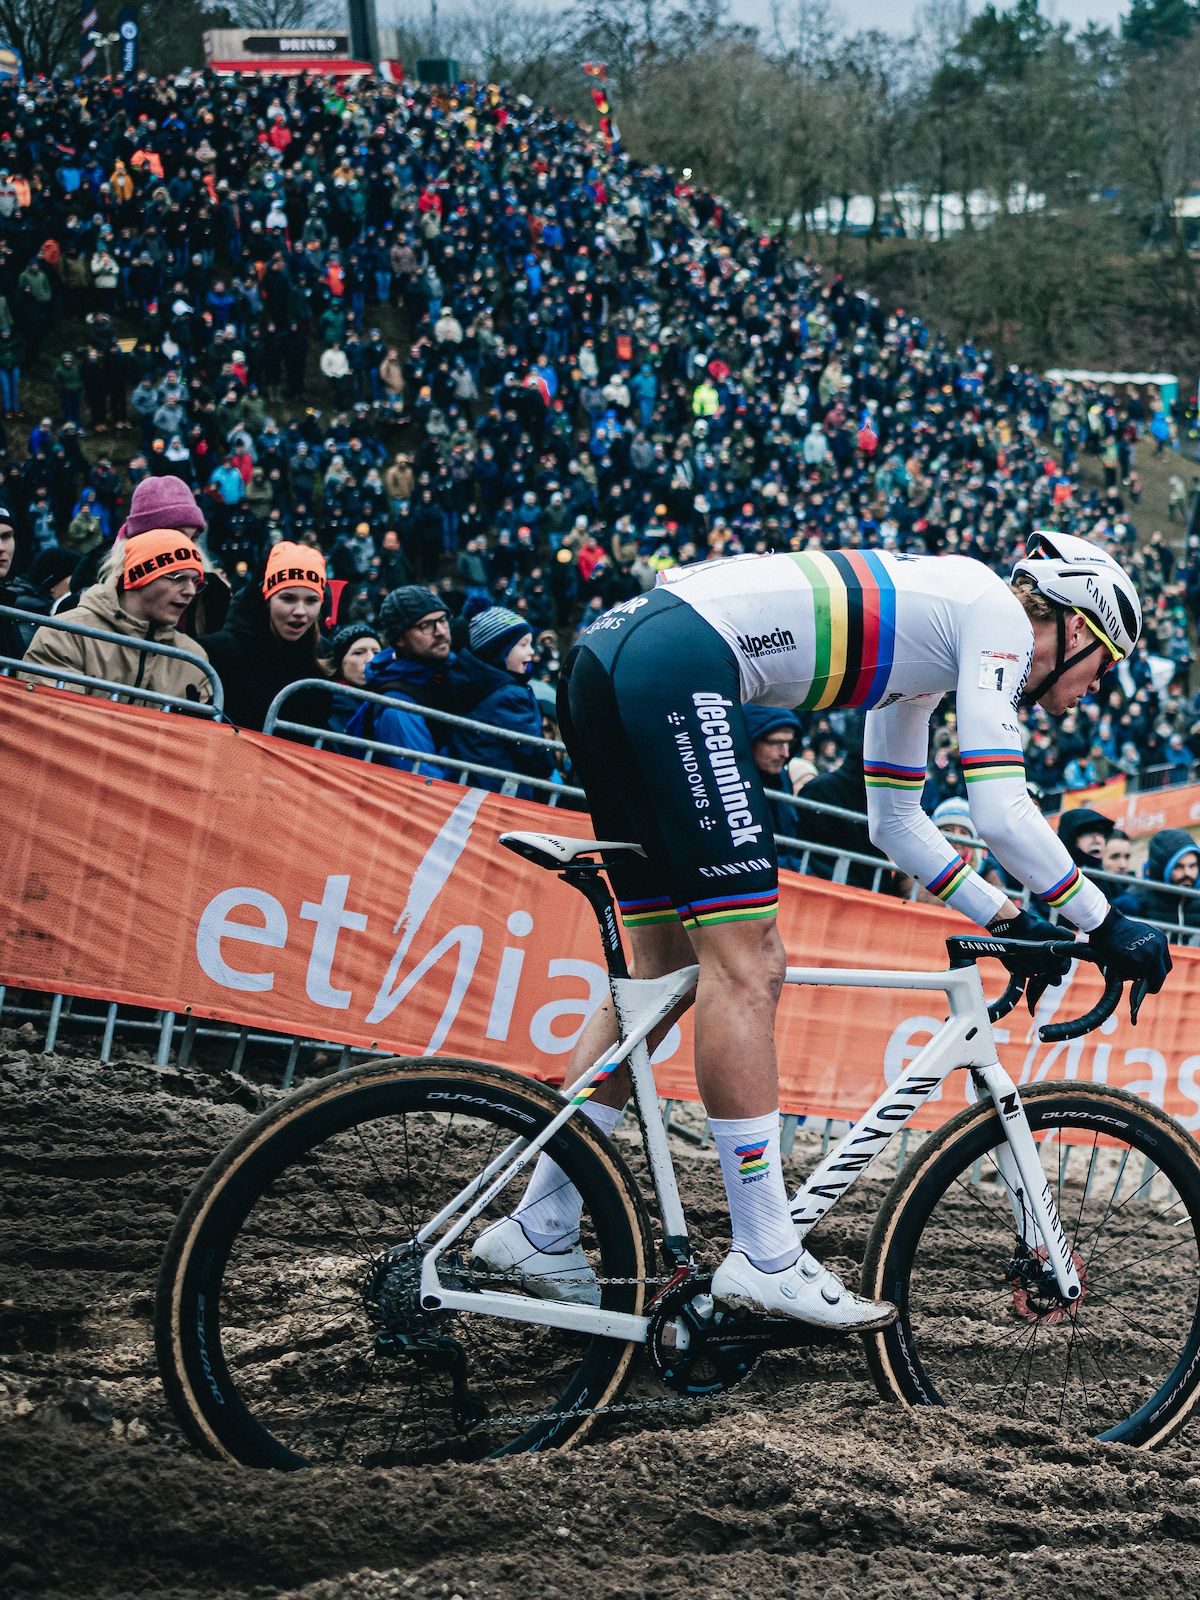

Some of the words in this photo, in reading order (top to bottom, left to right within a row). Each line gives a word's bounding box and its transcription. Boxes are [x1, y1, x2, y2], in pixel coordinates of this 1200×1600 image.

[279, 38, 337, 51] DRINKS
[1086, 577, 1121, 641] CANYON
[737, 627, 795, 657] Alpecin
[759, 644, 797, 657] BOOSTER
[994, 667, 1004, 692] 1
[674, 731, 710, 809] WINDOWS
[692, 692, 762, 848] deceuninck
[699, 857, 772, 878] CANYON
[196, 788, 682, 1066] ethia
[604, 905, 619, 951] CANYON
[959, 941, 1007, 953] CANYON
[426, 1092, 537, 1124] DURA-ACE
[1041, 1111, 1129, 1129] DURA-ACE
[789, 1076, 942, 1225] CANYON
[1042, 1182, 1074, 1275] CANYON
